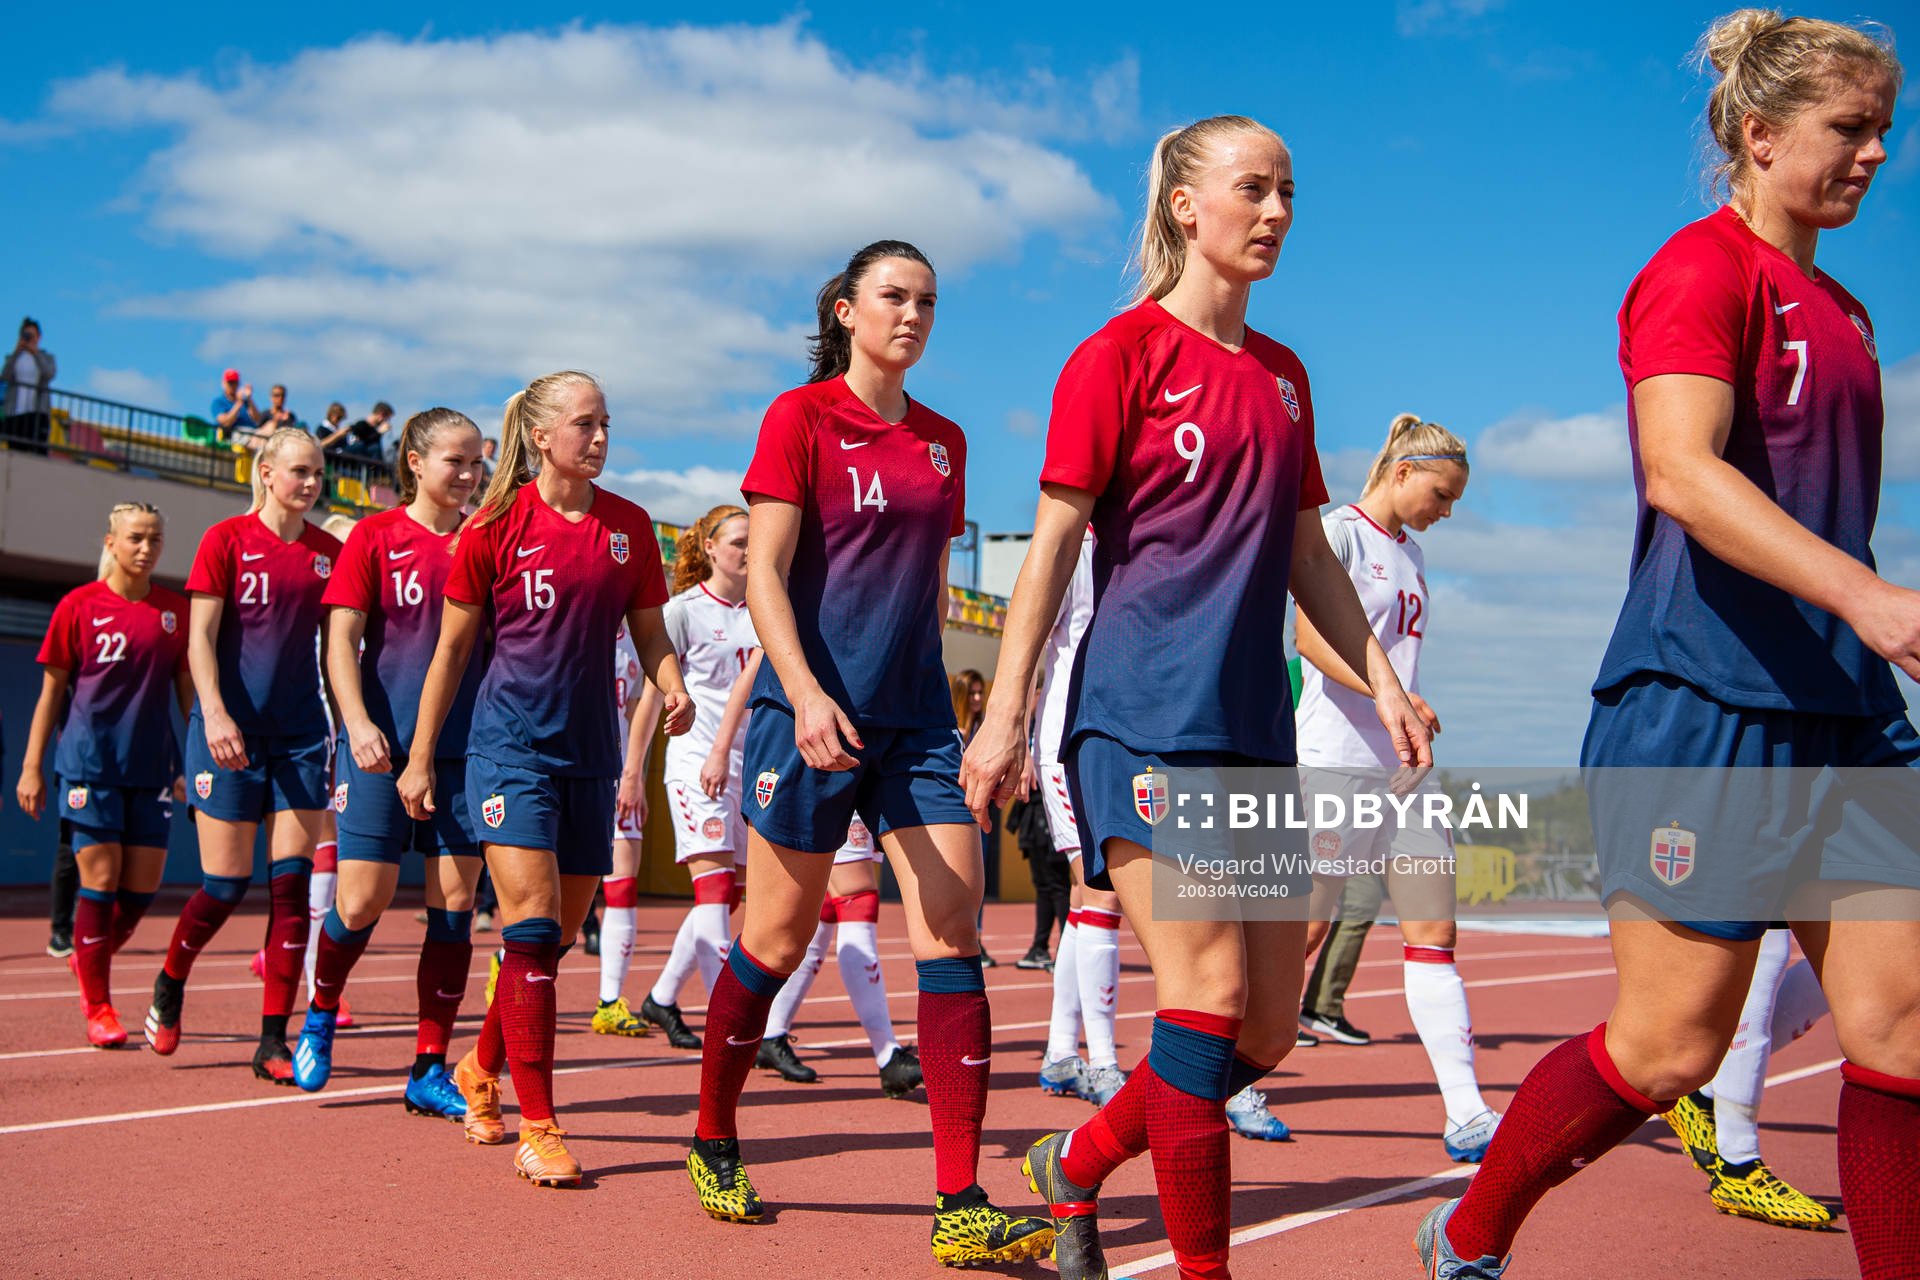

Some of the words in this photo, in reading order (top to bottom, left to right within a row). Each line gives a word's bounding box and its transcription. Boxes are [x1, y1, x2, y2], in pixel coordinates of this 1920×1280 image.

[1782, 340, 1808, 406] 7
[1173, 422, 1206, 483] 9
[847, 466, 888, 513] 14
[240, 572, 269, 605] 21
[391, 570, 424, 607] 16
[521, 568, 556, 611] 15
[1397, 589, 1422, 640] 12
[95, 631, 127, 664] 22
[736, 646, 756, 675] 1
